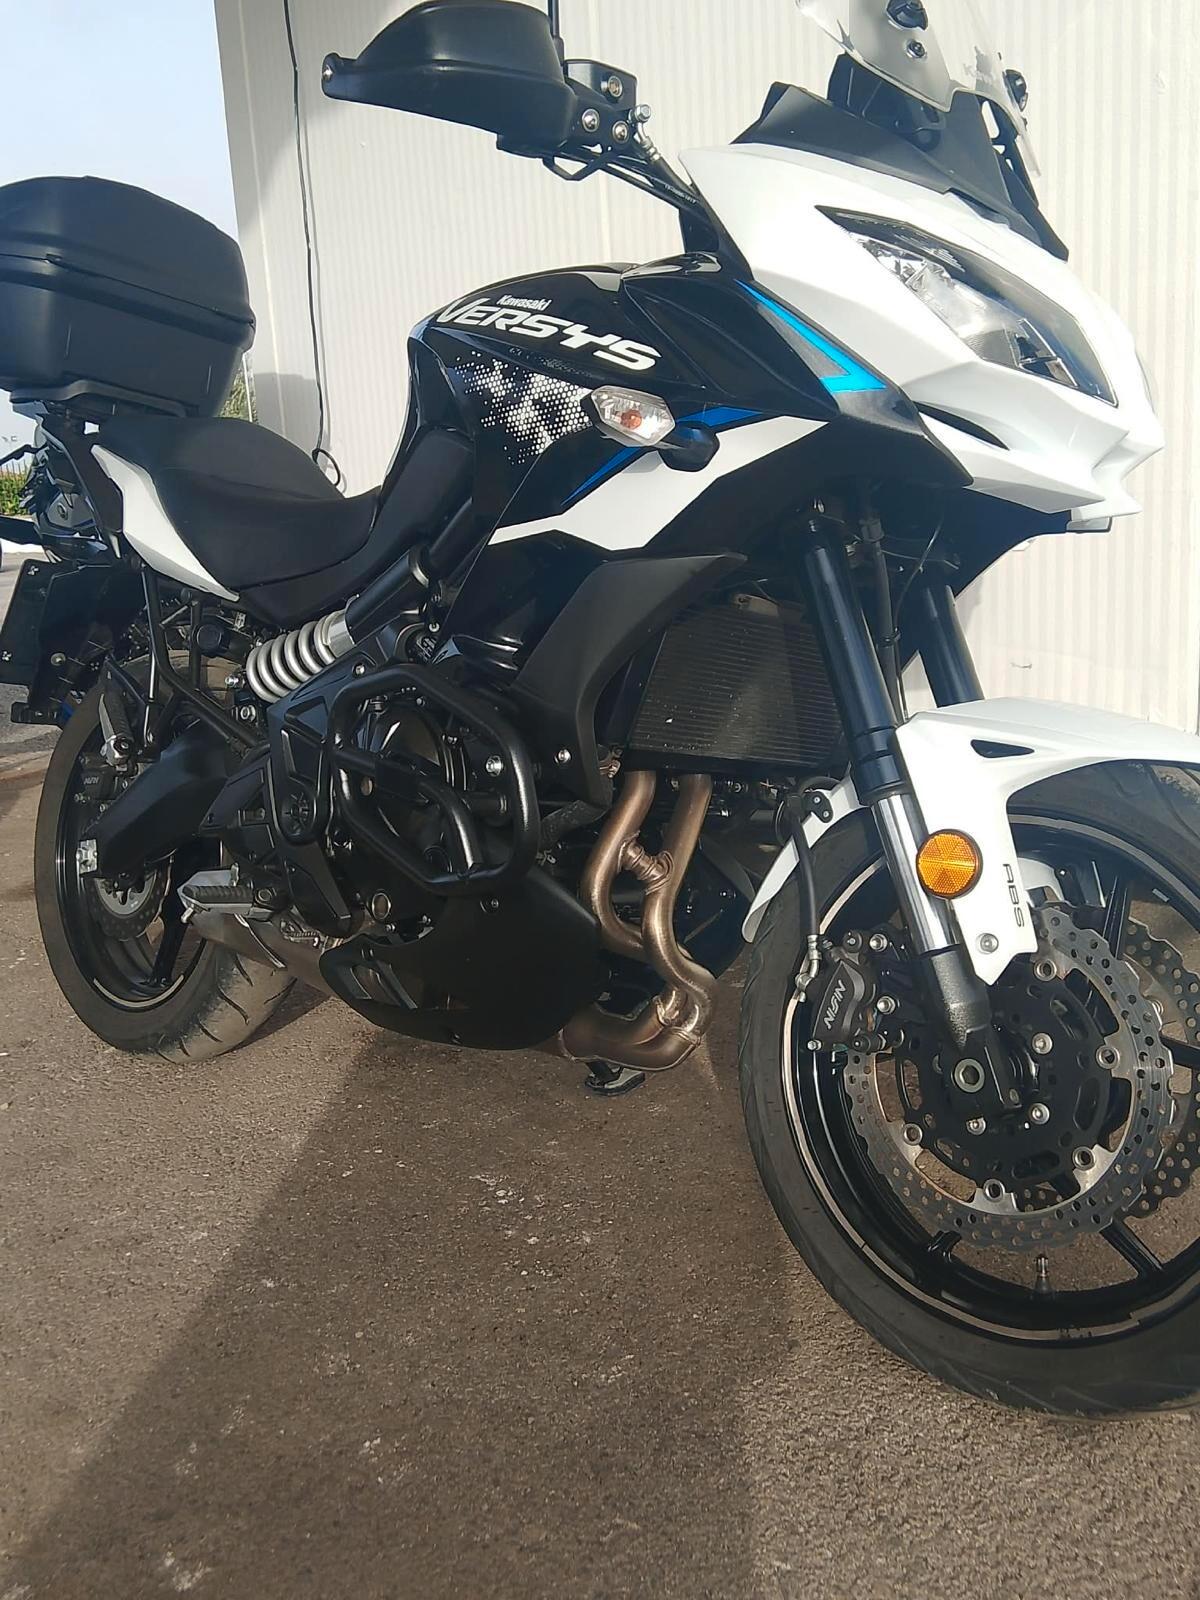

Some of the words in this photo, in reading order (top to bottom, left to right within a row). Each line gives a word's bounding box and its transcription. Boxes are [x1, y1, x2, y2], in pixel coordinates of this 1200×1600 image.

[436, 298, 662, 370] VERSYS
[496, 294, 552, 311] Kawasaki
[1003, 863, 1025, 927] ABS
